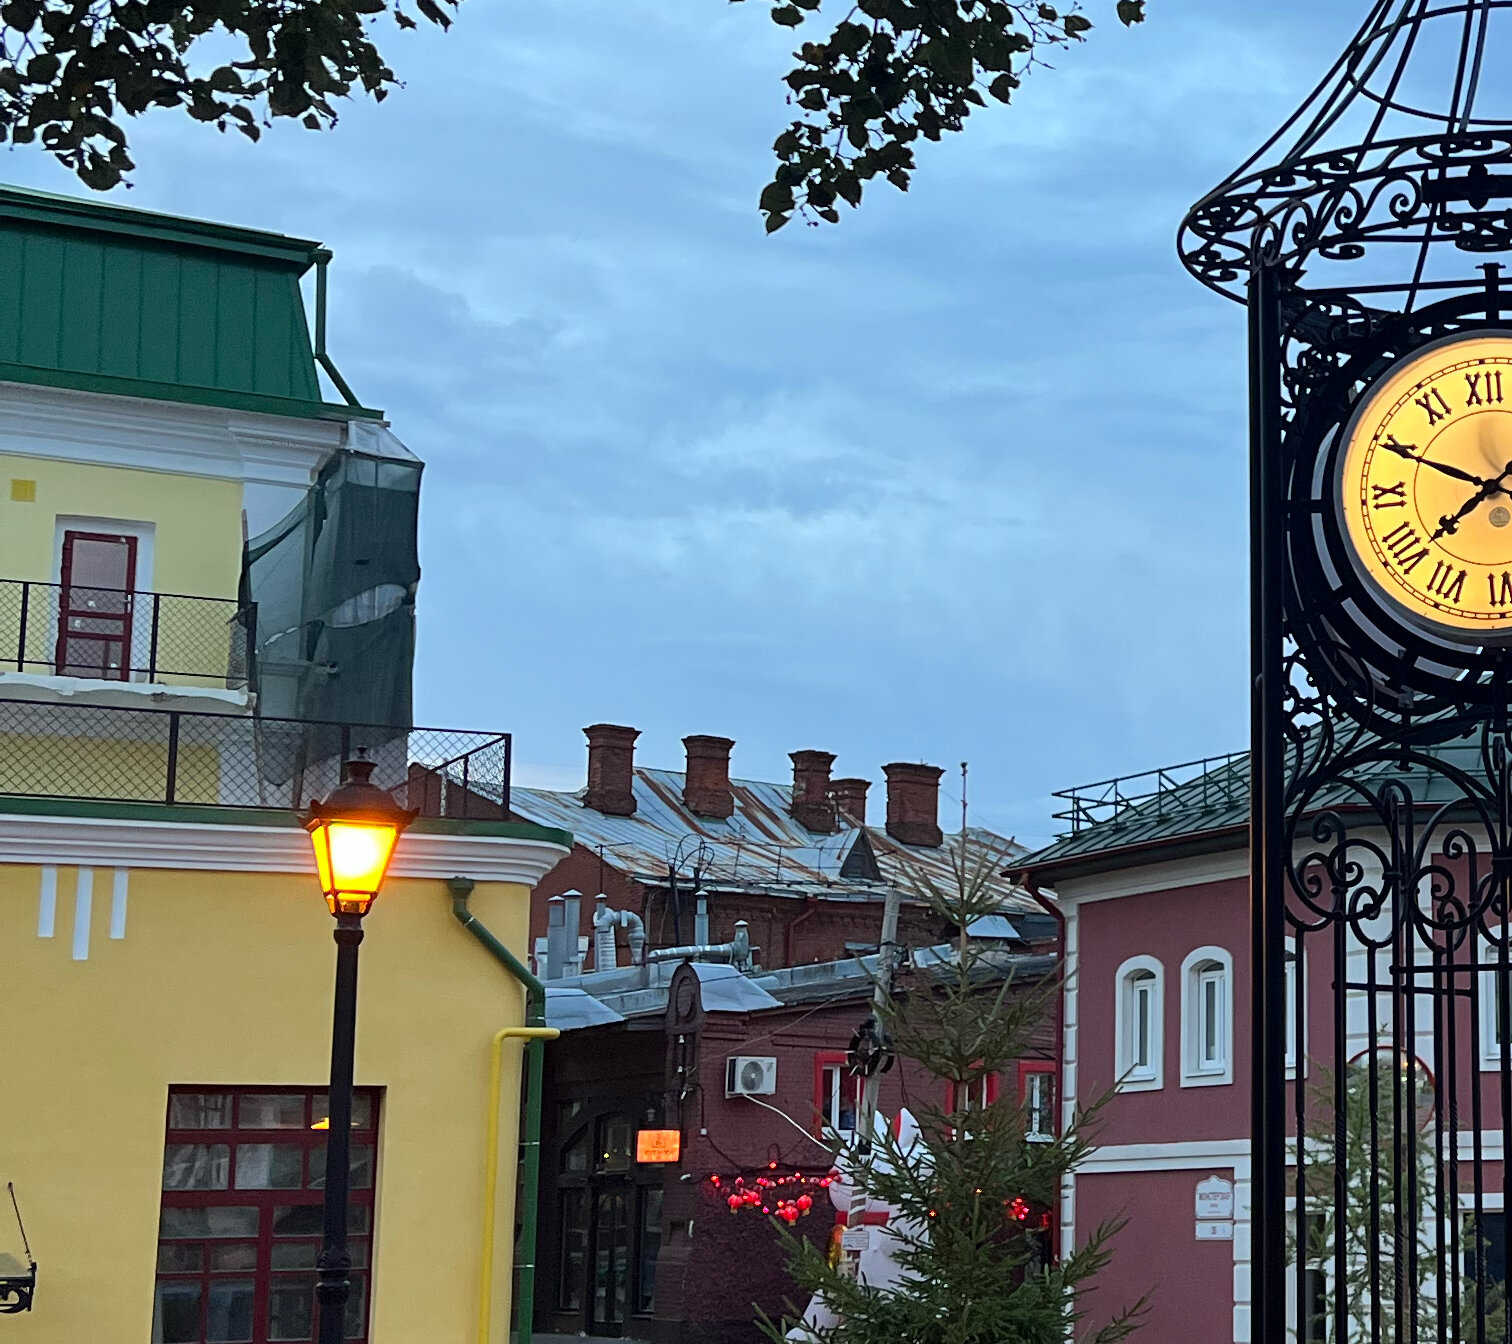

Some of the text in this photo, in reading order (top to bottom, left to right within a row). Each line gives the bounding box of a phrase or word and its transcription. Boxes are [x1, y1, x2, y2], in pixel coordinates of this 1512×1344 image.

[1415, 387, 1452, 426] XI
[1465, 370, 1503, 407] XII
[1371, 481, 1407, 510] IX
[1382, 521, 1430, 575] VIII
[1426, 560, 1468, 604] VII
